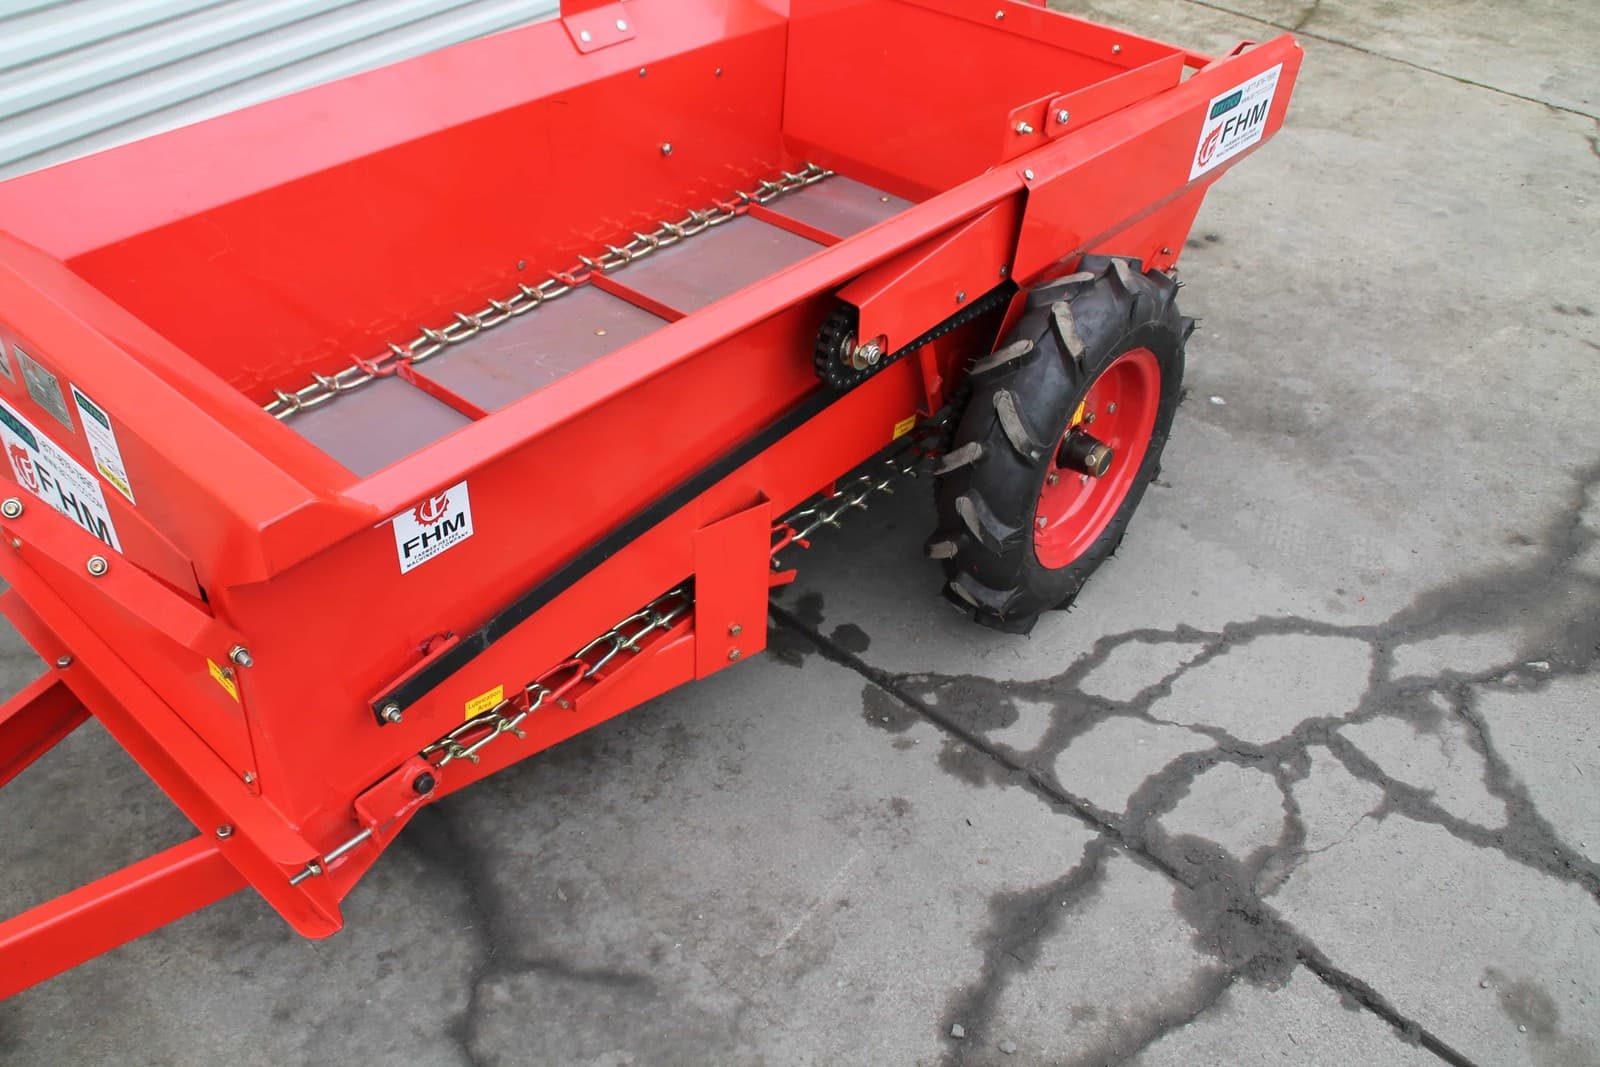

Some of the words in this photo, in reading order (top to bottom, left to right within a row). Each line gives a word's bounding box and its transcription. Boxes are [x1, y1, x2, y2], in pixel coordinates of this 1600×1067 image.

[1220, 99, 1268, 144] FHM
[33, 460, 114, 549] FHM
[402, 511, 465, 559] FHM
[406, 546, 440, 569] MACHINERY
[441, 531, 469, 549] COMPANY
[468, 690, 501, 710] Lubrication
[478, 701, 492, 712] Area
